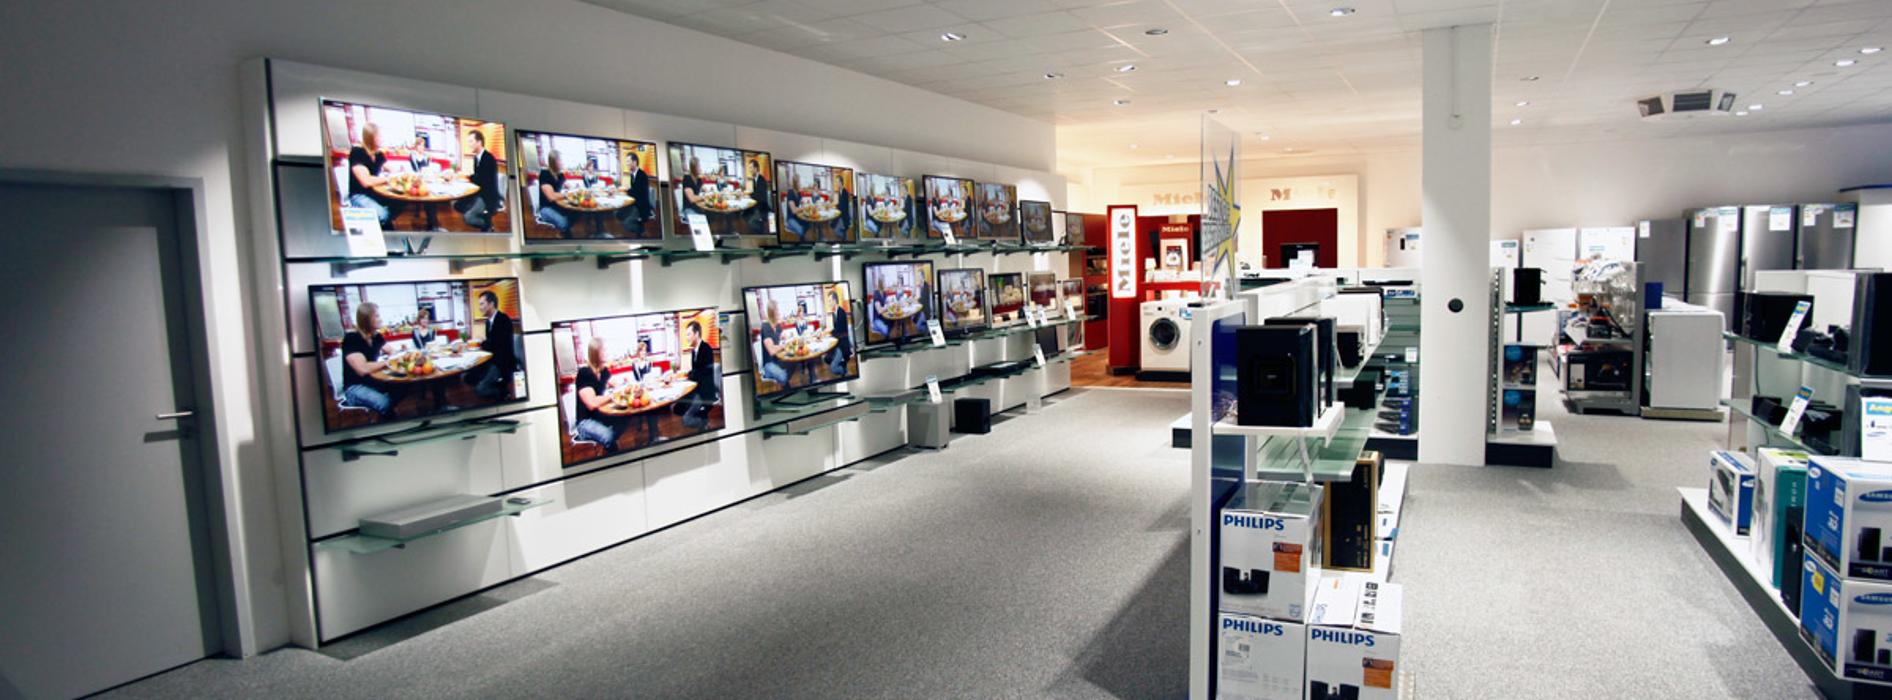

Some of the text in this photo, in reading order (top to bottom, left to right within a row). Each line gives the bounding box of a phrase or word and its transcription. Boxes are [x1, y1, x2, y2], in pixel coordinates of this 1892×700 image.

[1153, 192, 1201, 206] Miel
[1117, 213, 1131, 292] Miele
[1223, 514, 1285, 531] PHILIPS
[1222, 617, 1284, 636] PHILIPS
[1311, 628, 1376, 647] PHILIPS
